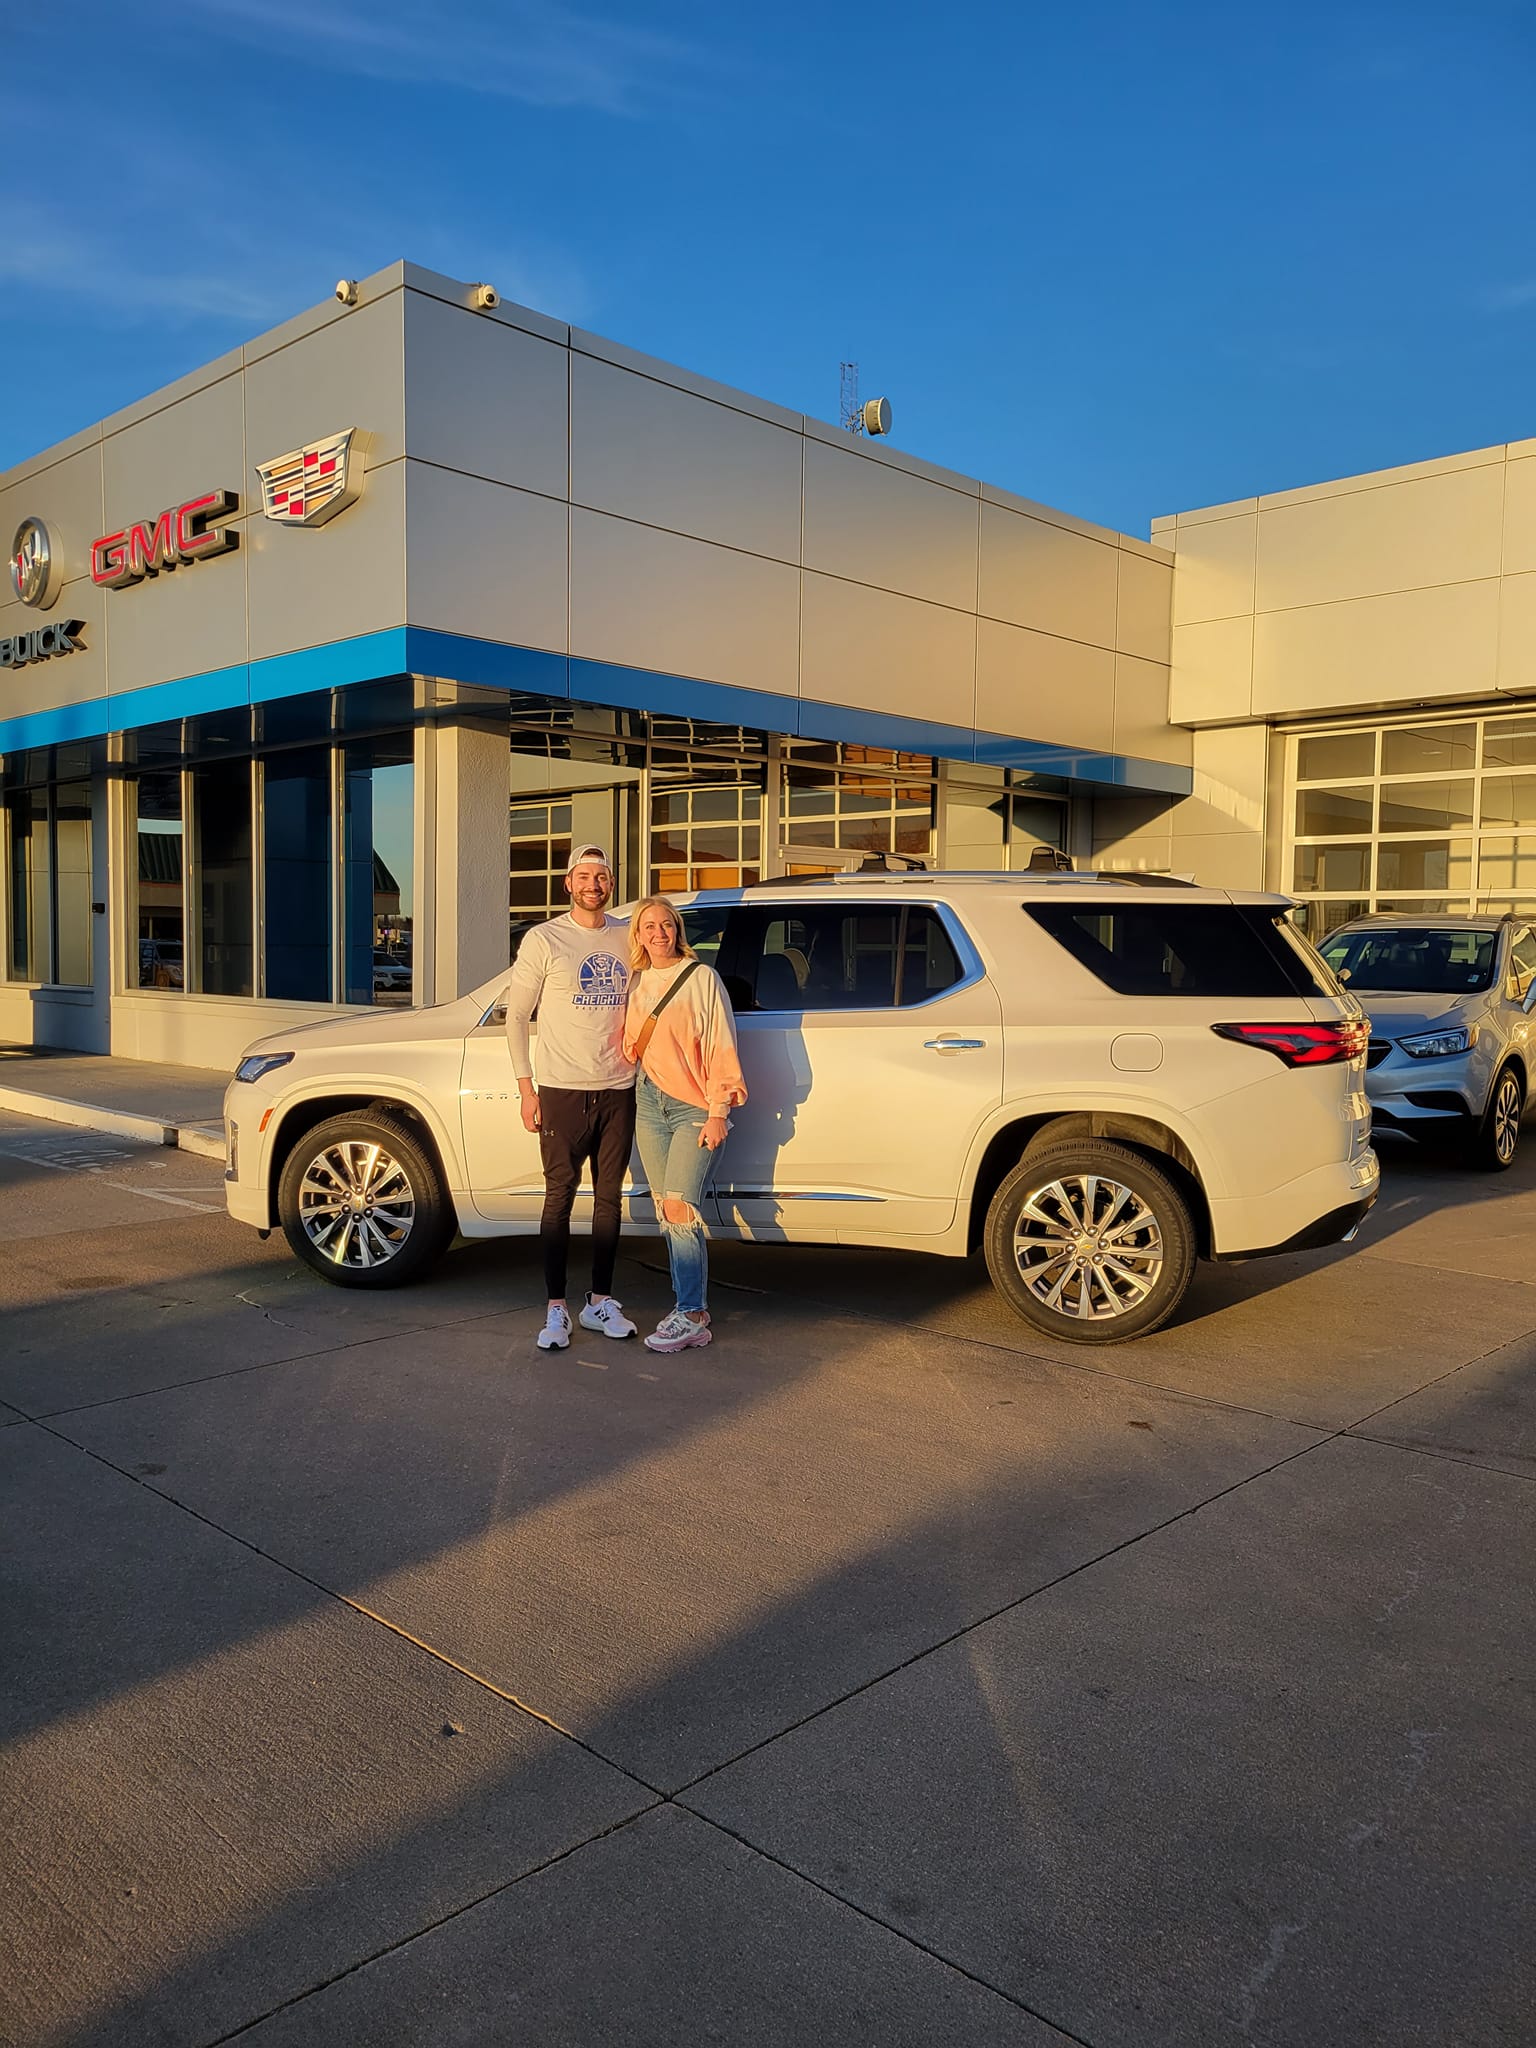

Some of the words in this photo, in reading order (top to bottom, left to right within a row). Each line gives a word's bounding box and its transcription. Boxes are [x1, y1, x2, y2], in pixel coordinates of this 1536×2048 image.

[90, 488, 233, 588] GMC
[0, 619, 80, 667] BUICK
[1153, 1190, 1183, 1297] CONTINENTAL
